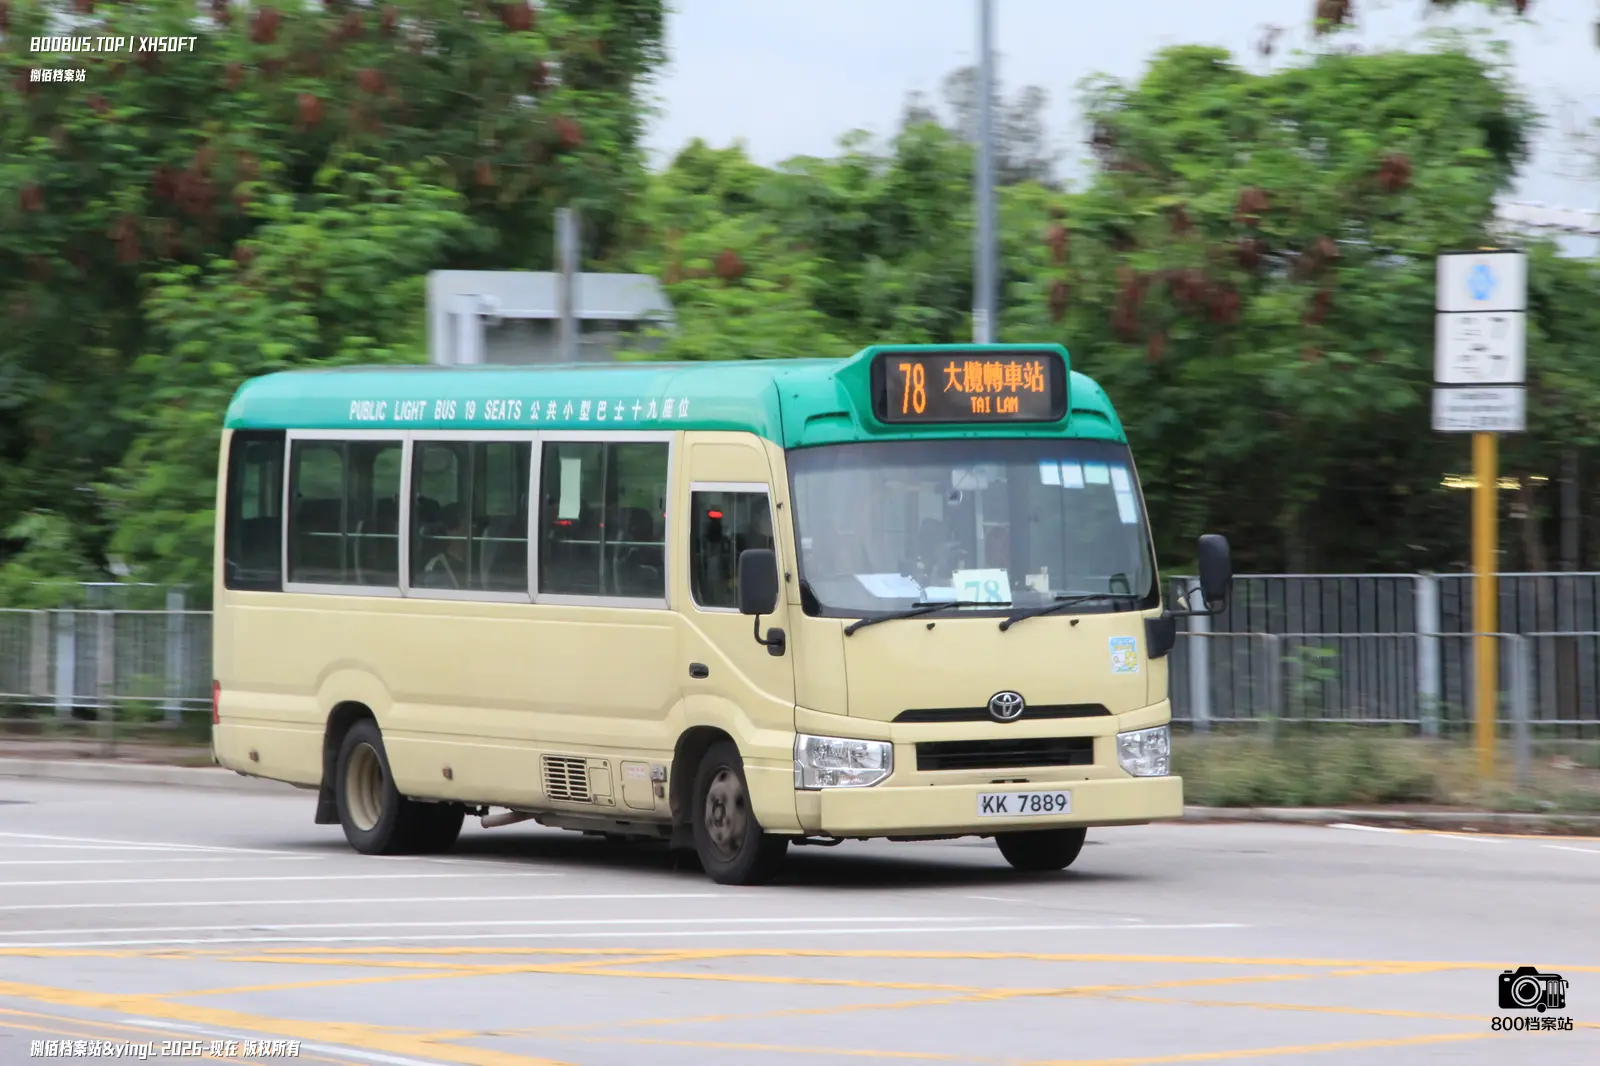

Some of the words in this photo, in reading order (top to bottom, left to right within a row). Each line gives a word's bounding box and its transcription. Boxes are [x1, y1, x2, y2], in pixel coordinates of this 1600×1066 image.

[899, 362, 927, 414] 78
[349, 400, 388, 421] PUBLIC
[393, 400, 427, 421] LIGHT
[434, 400, 457, 420] BUS
[465, 400, 477, 420] 19
[484, 399, 522, 421] SEATS
[530, 396, 690, 421] 公共小型巴士十九座位
[970, 396, 991, 413] TAI
[996, 396, 1019, 413] LAM
[964, 579, 1003, 609] 78
[982, 795, 1008, 813] KK
[1017, 793, 1067, 812] 7889
